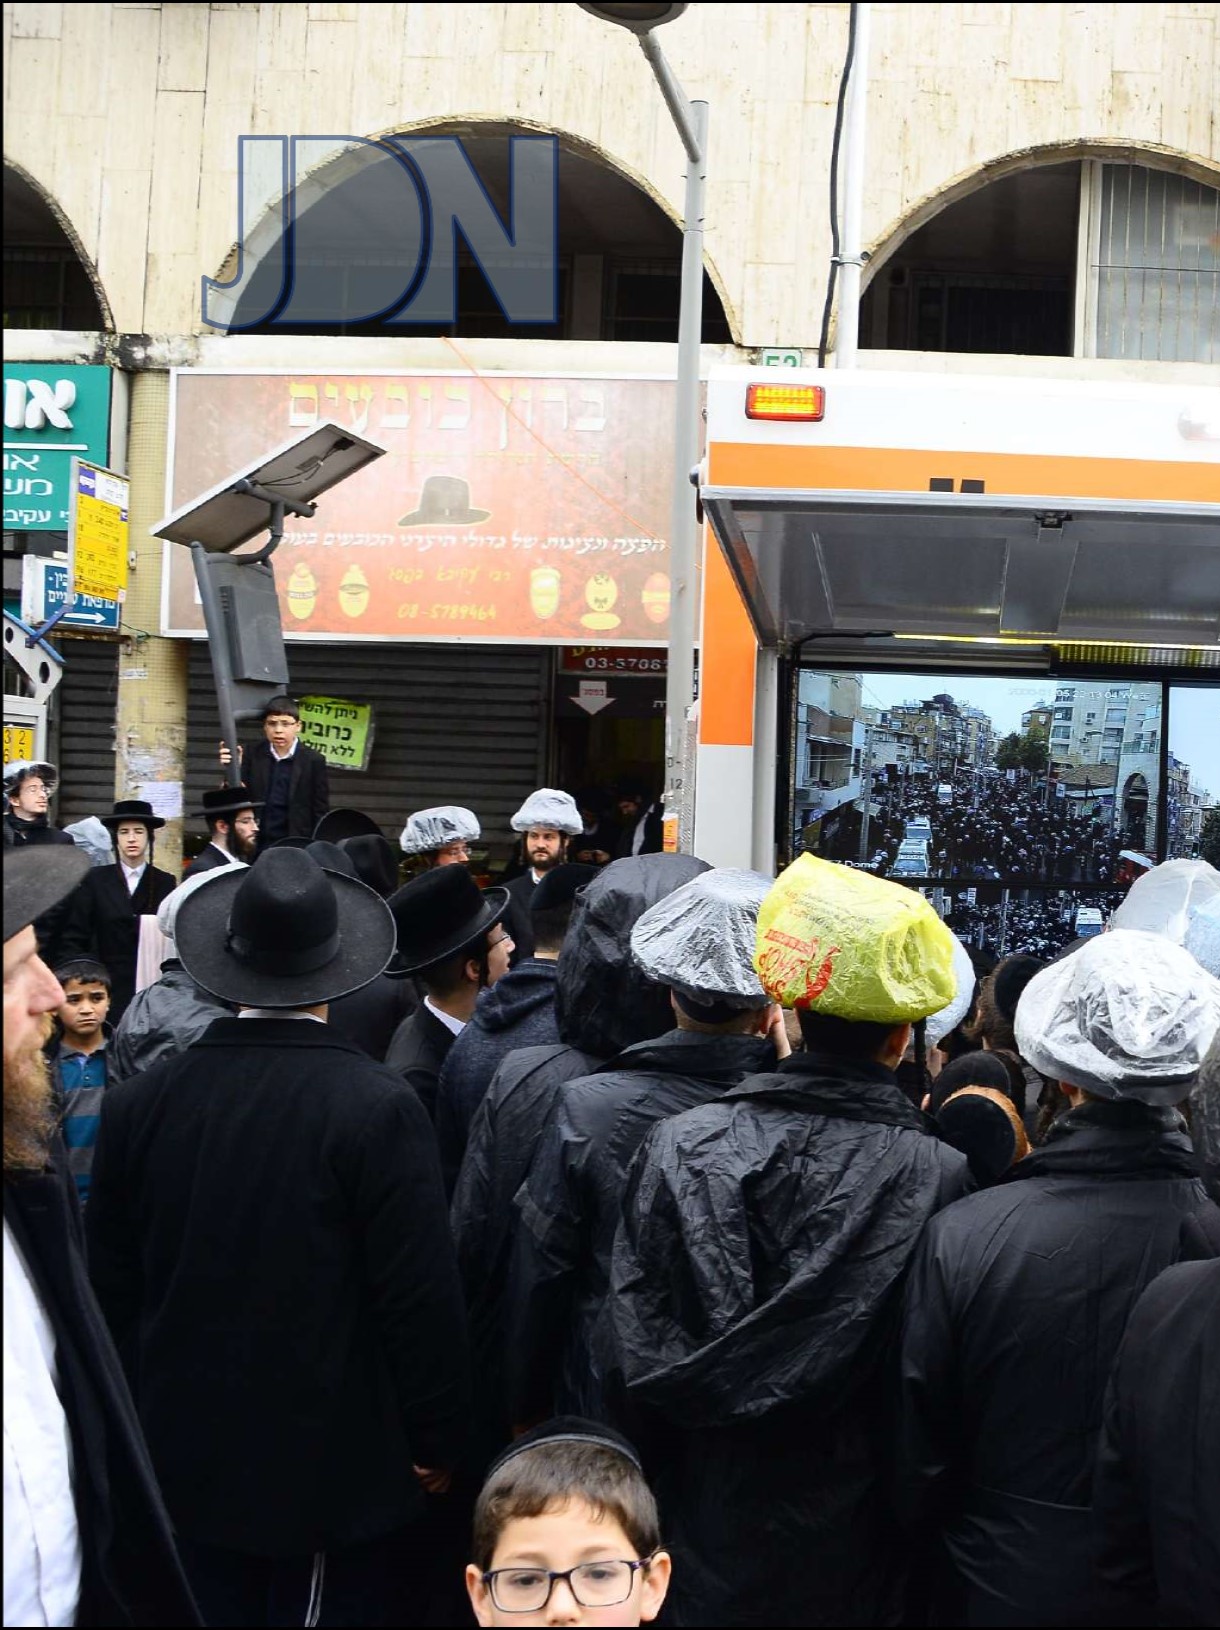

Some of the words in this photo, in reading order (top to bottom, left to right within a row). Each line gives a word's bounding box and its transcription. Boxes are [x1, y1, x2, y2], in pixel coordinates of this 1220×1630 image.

[288, 381, 471, 434] כובעים
[3, 509, 51, 525] עקיב
[512, 529, 538, 549] של
[304, 702, 333, 715] להש
[334, 706, 358, 719] ניתן
[330, 743, 355, 757] ללא
